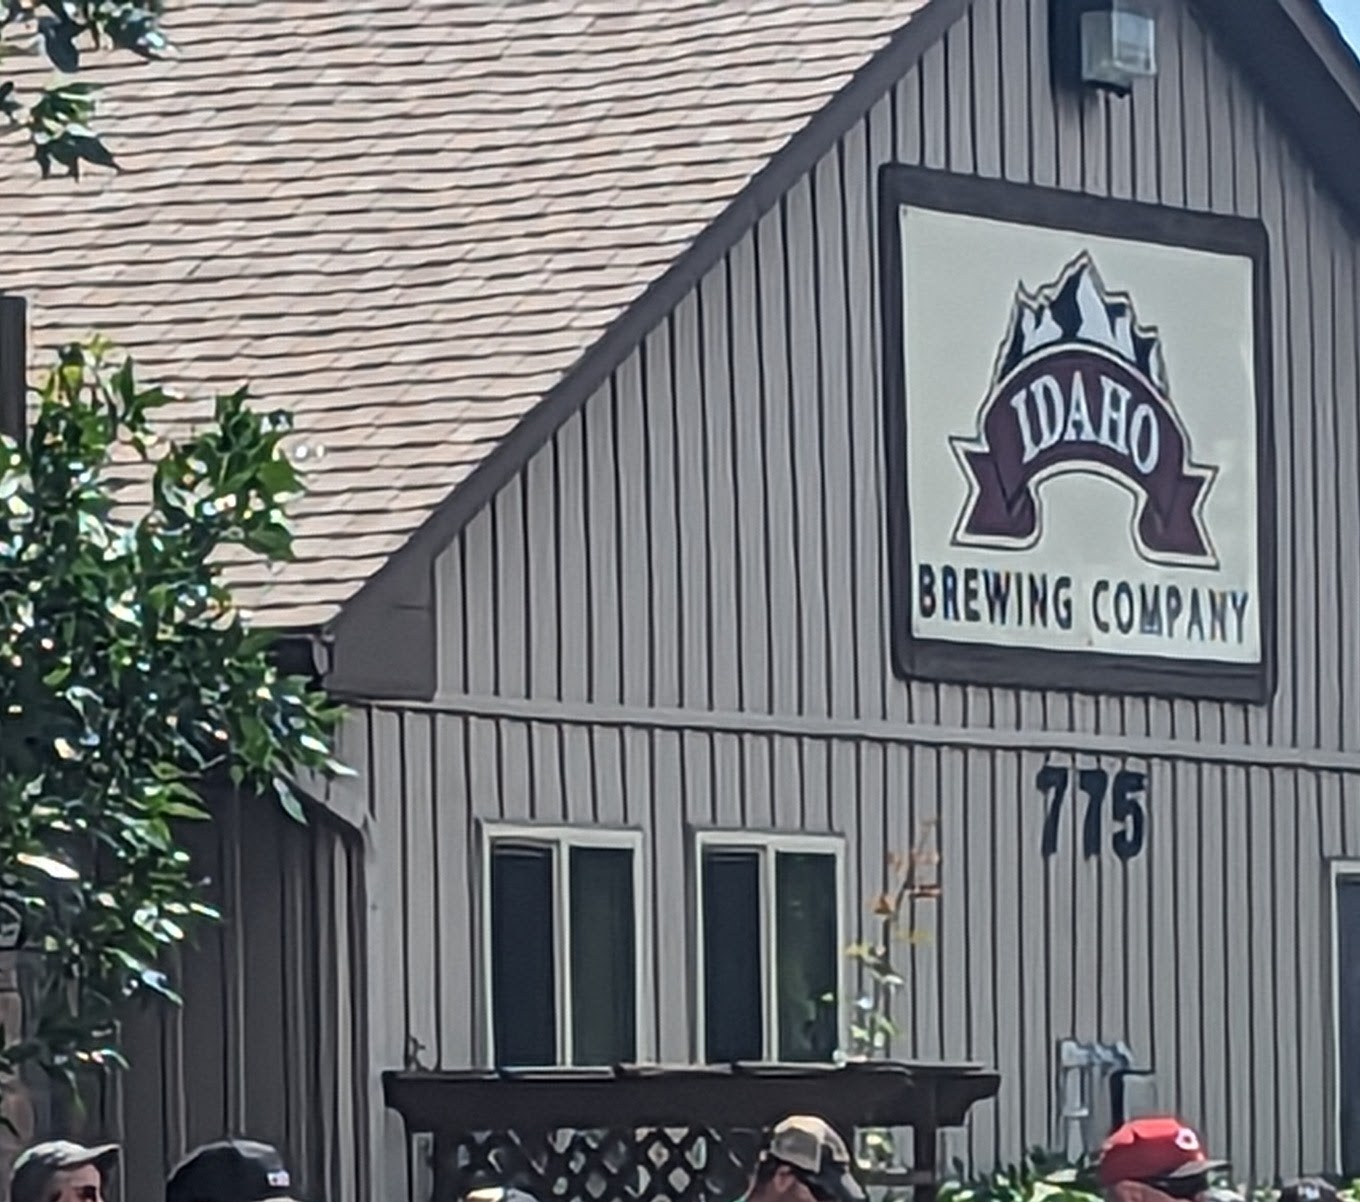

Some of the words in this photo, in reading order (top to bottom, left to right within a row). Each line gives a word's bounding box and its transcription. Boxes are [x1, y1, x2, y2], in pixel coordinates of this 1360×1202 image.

[1009, 369, 1160, 475] IDAHO
[917, 563, 1073, 630] BREWING
[1091, 579, 1249, 645] COMPANY
[1036, 765, 1146, 861] 775
